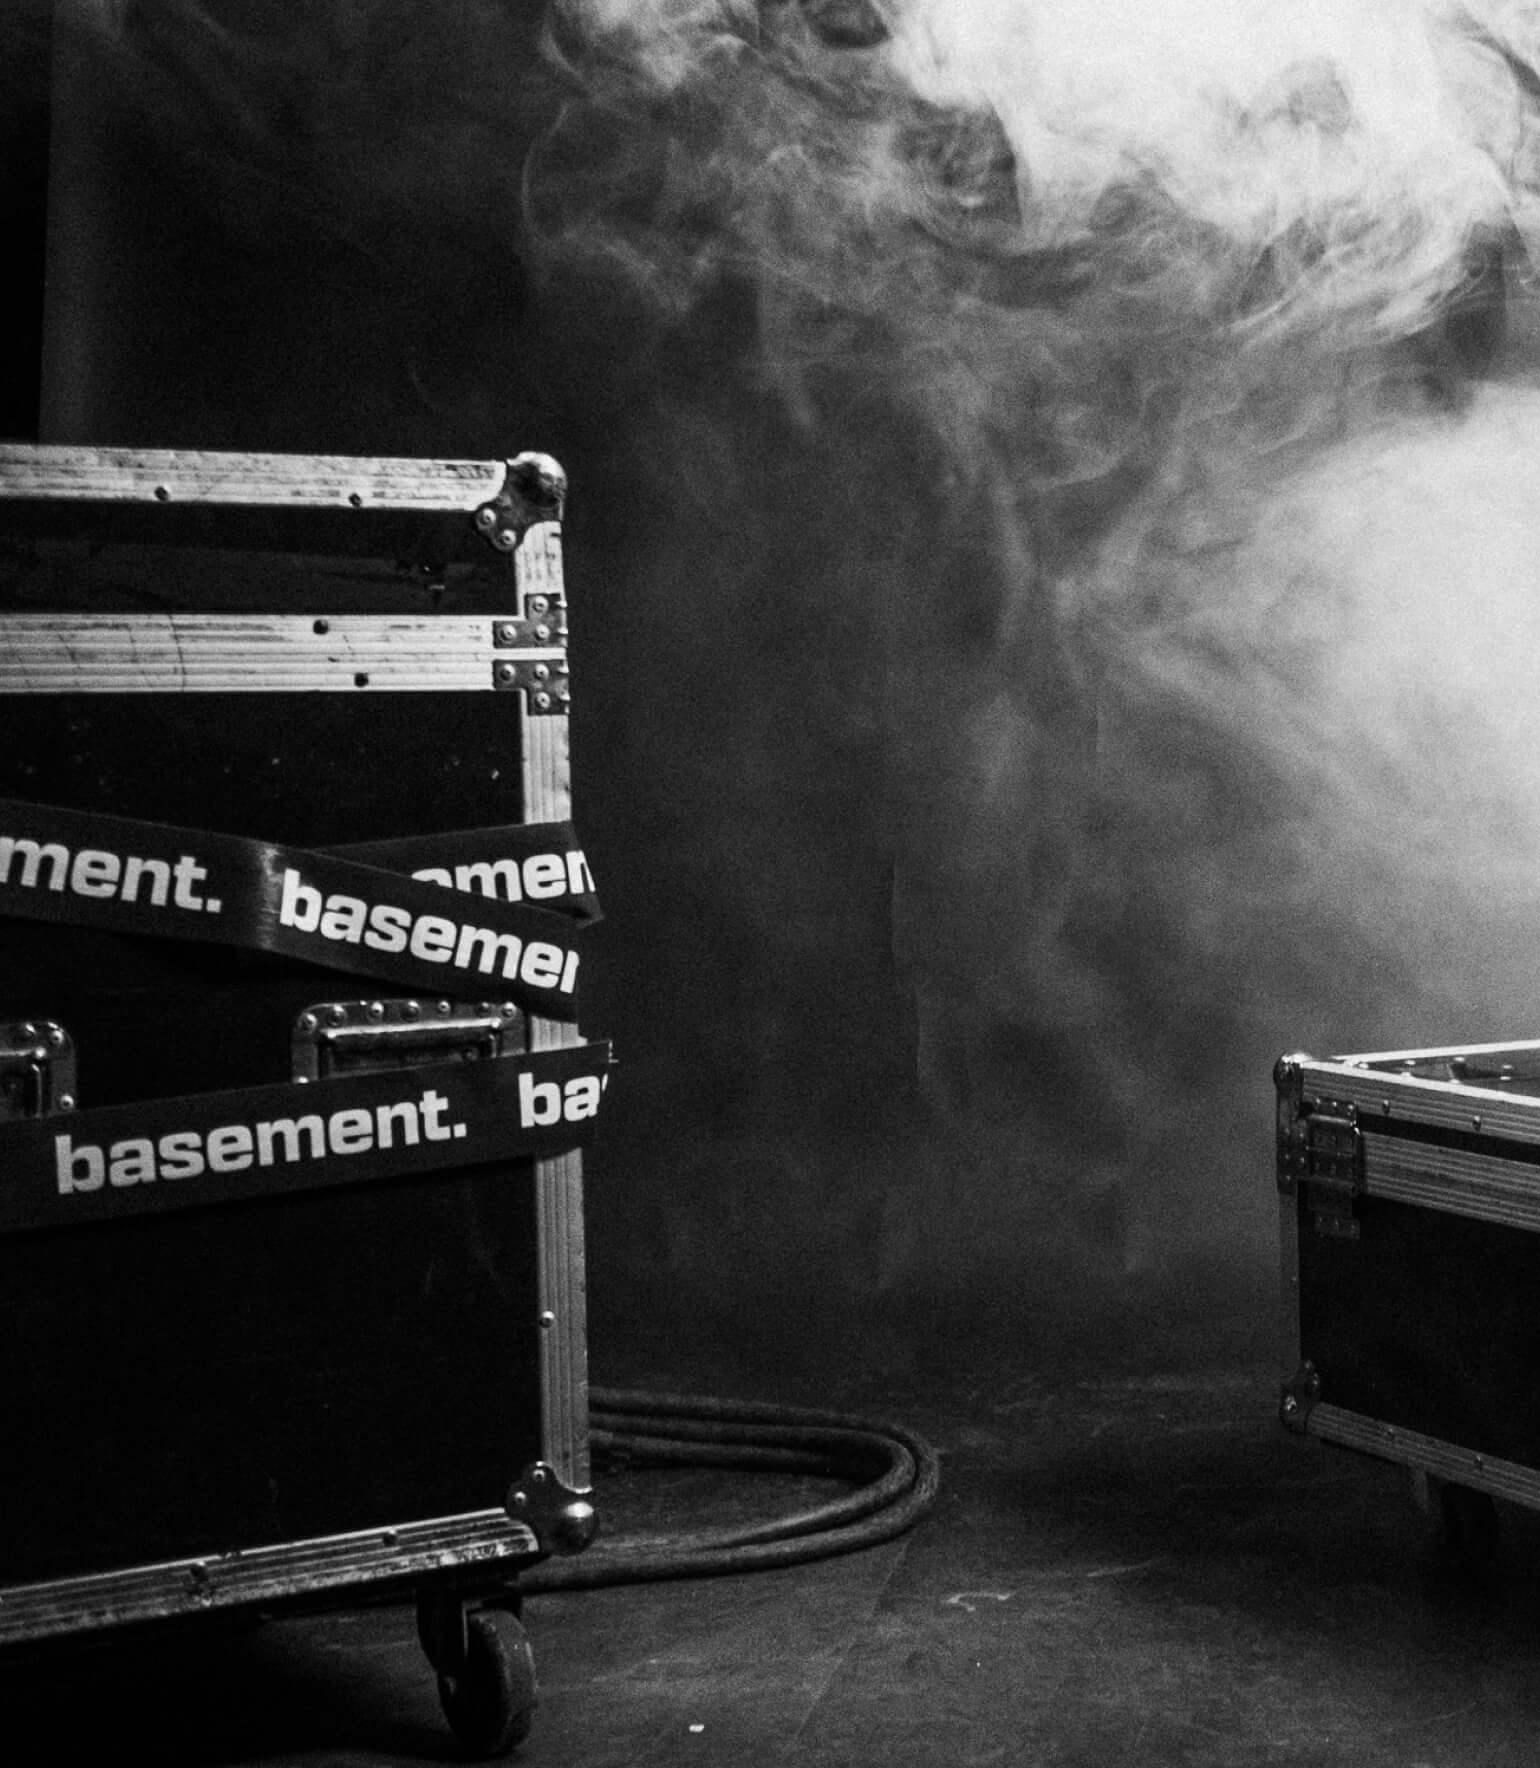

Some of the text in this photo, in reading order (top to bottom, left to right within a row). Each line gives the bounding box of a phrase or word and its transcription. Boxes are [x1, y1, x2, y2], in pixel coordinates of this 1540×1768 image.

[0, 836, 222, 913] ment.
[55, 1071, 609, 1193] basement. ba
